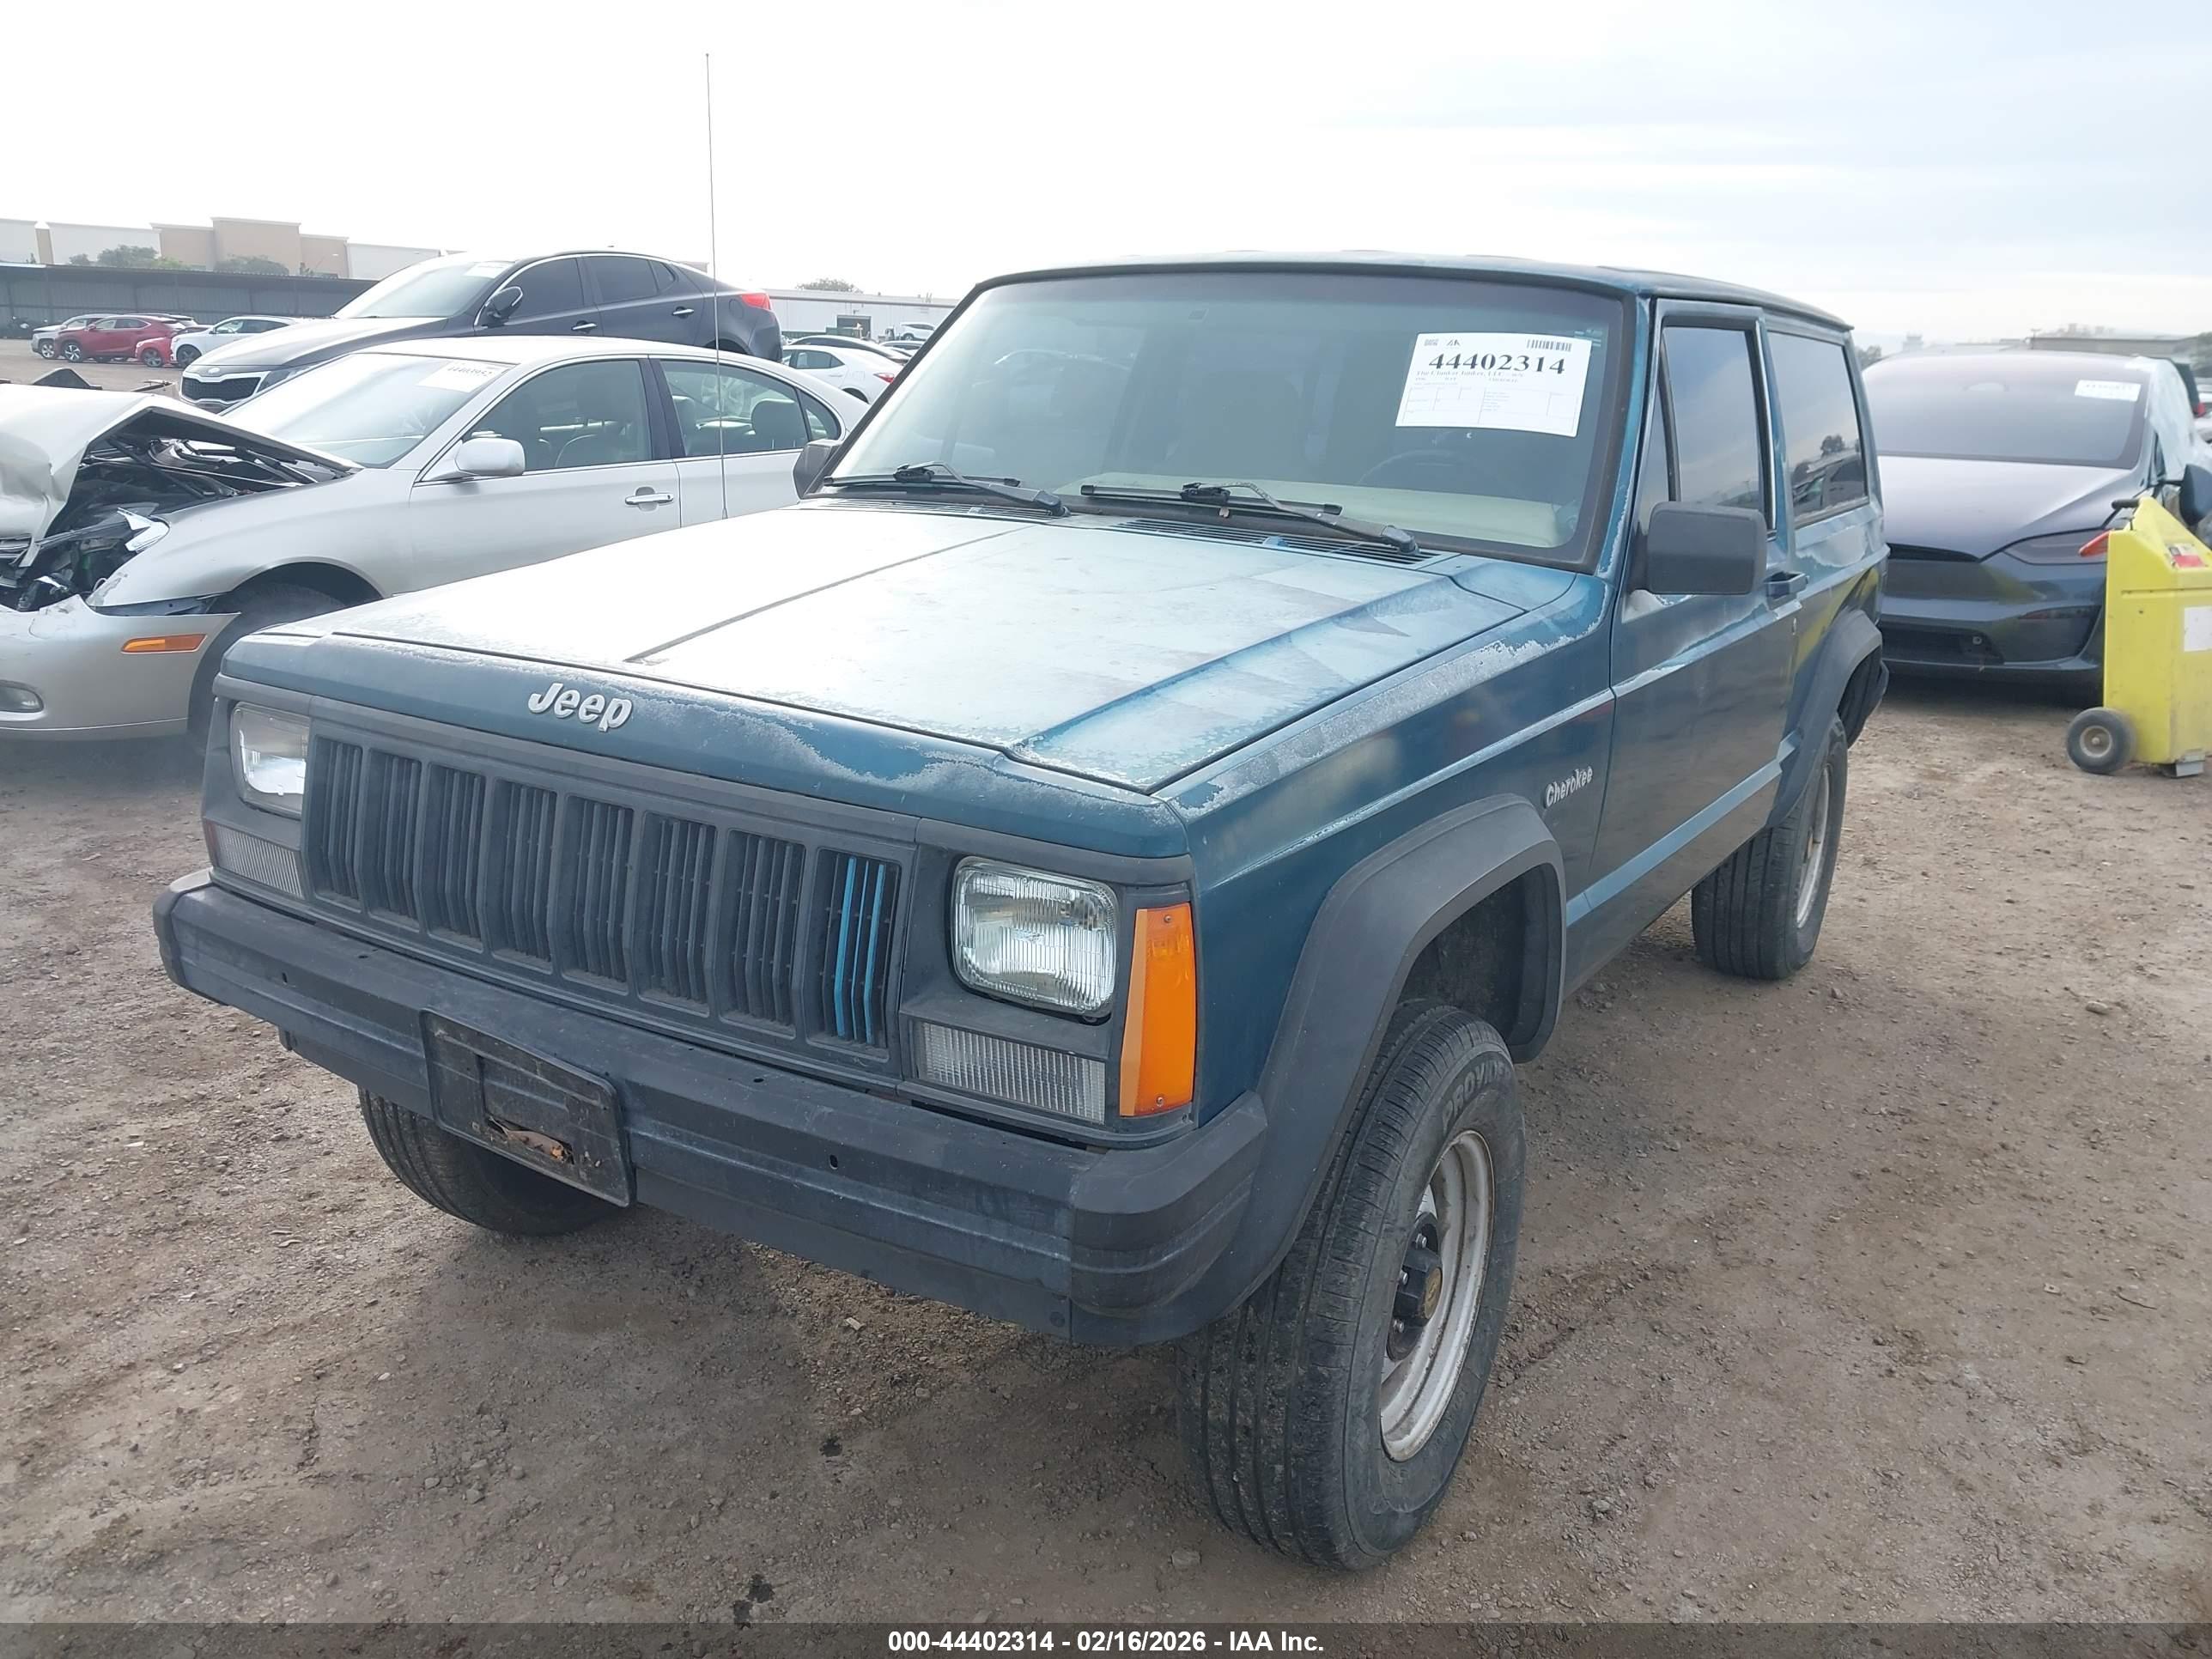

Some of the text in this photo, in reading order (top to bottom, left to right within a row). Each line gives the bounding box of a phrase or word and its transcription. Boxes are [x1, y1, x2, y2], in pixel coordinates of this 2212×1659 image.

[1428, 353, 1565, 374] 44402314
[528, 683, 633, 732] Jeep
[1546, 765, 1593, 807] Cherokee
